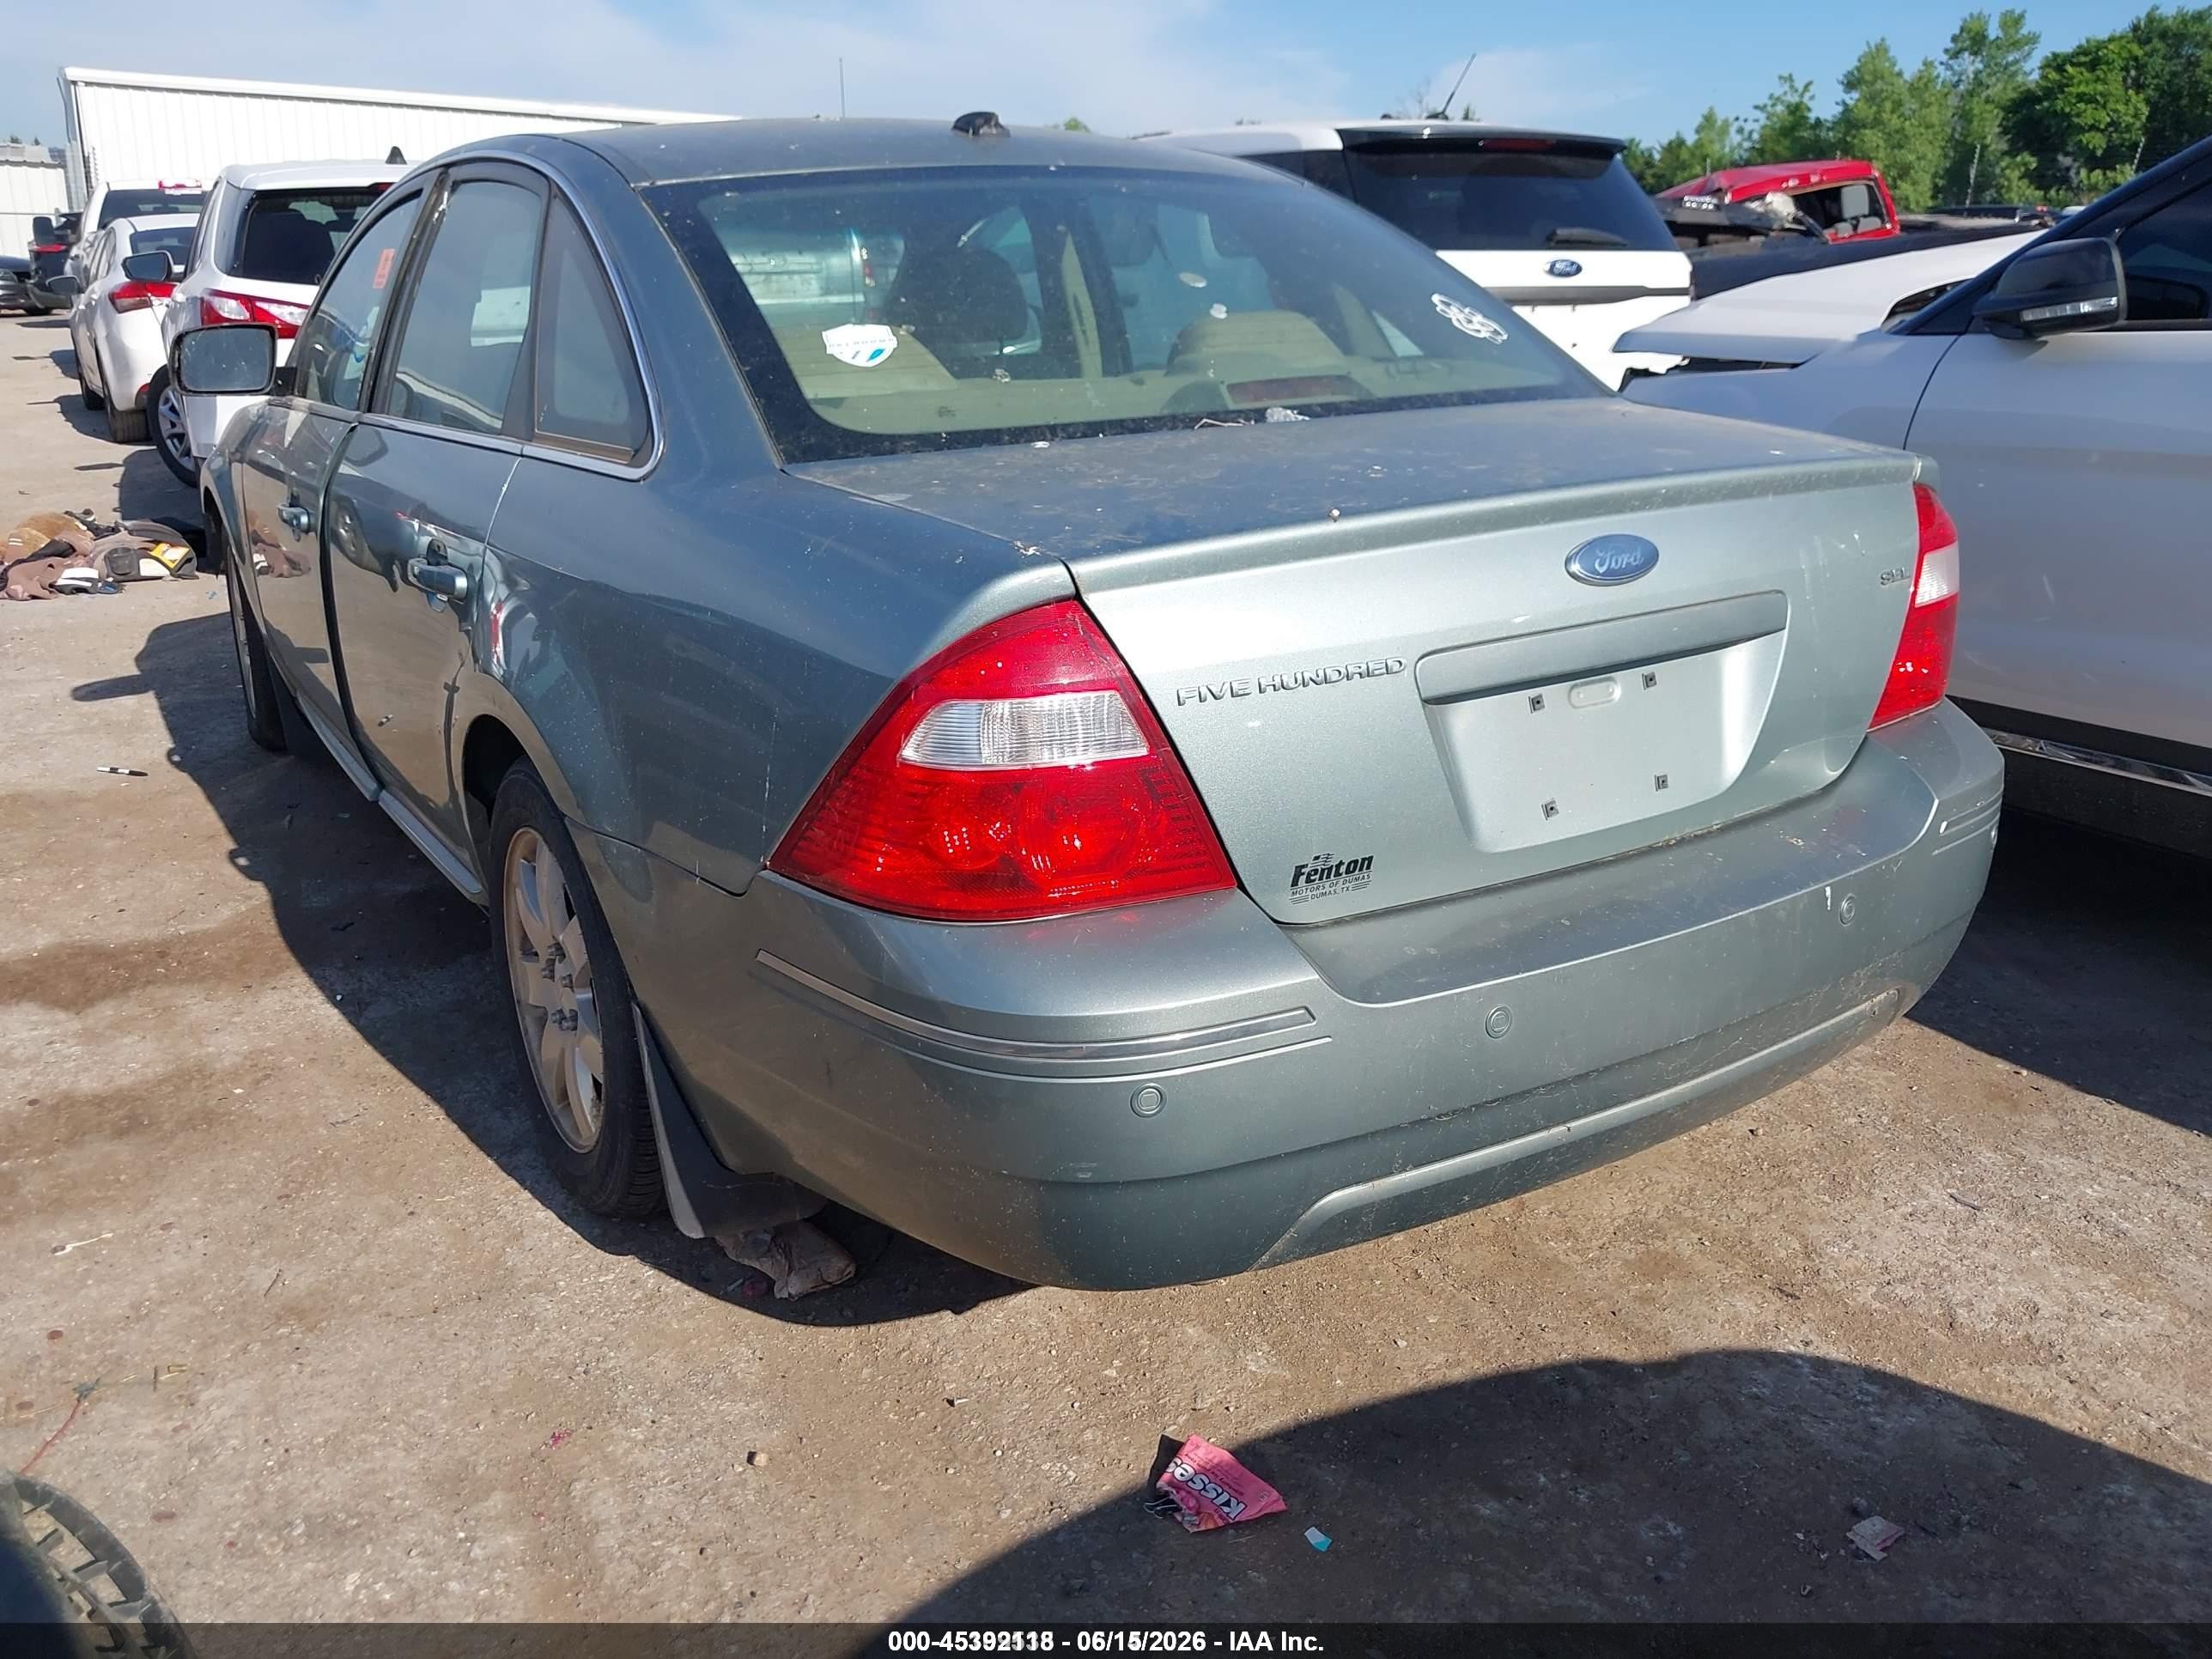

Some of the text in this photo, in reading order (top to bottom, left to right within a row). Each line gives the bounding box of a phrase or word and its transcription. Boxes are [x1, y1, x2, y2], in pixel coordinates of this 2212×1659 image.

[1595, 544, 1644, 574] Ford
[1881, 567, 1911, 586] SEL
[1177, 657, 1407, 706] FIVE HUNDRED
[1291, 855, 1374, 888] Fenton
[1291, 873, 1371, 897] MOTORS OF DUMAS
